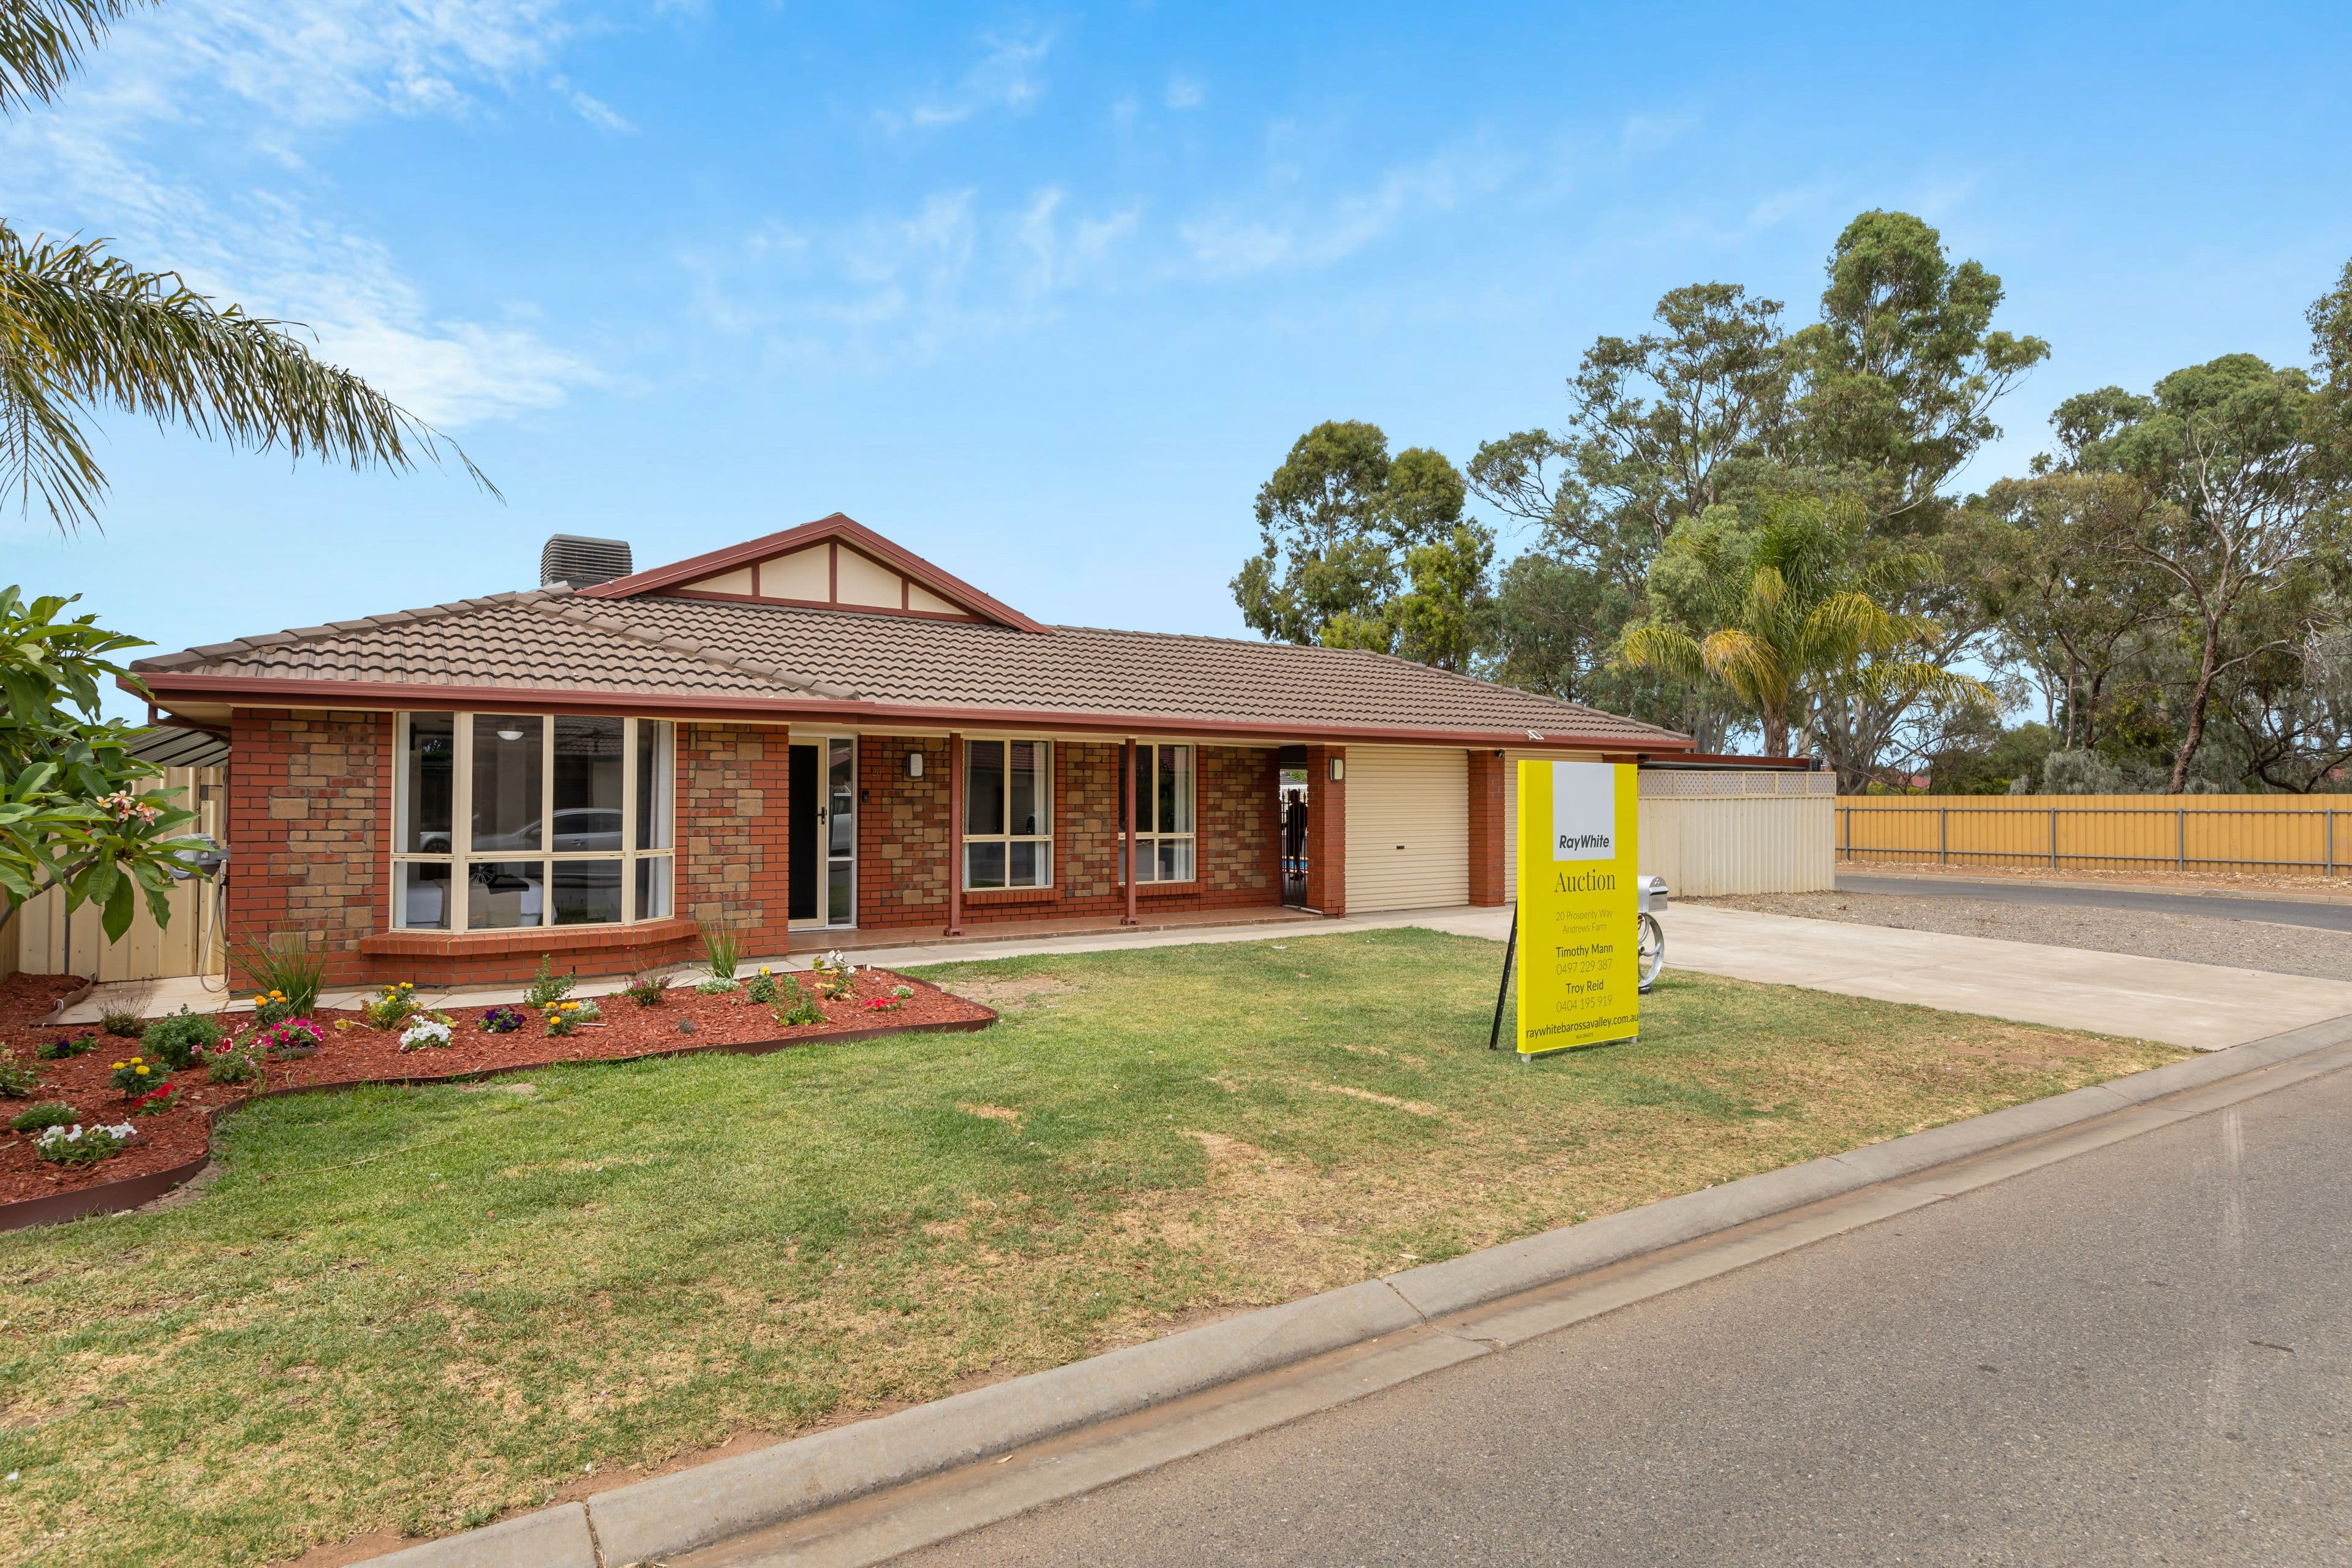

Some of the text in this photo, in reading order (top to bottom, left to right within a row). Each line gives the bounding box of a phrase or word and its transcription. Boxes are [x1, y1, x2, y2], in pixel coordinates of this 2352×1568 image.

[1555, 869, 1616, 892] Auction
[1556, 909, 1613, 921] 20 Prosperity Way
[1562, 922, 1607, 934] Andrews Farm
[1556, 943, 1613, 958] Timothy Mann
[1556, 959, 1613, 975] 0497 229 387
[1566, 979, 1604, 995] Troy Reid
[1556, 995, 1613, 1012] 0404 195 919
[1526, 1014, 1638, 1039] raywhitebarossavalley.com.au
